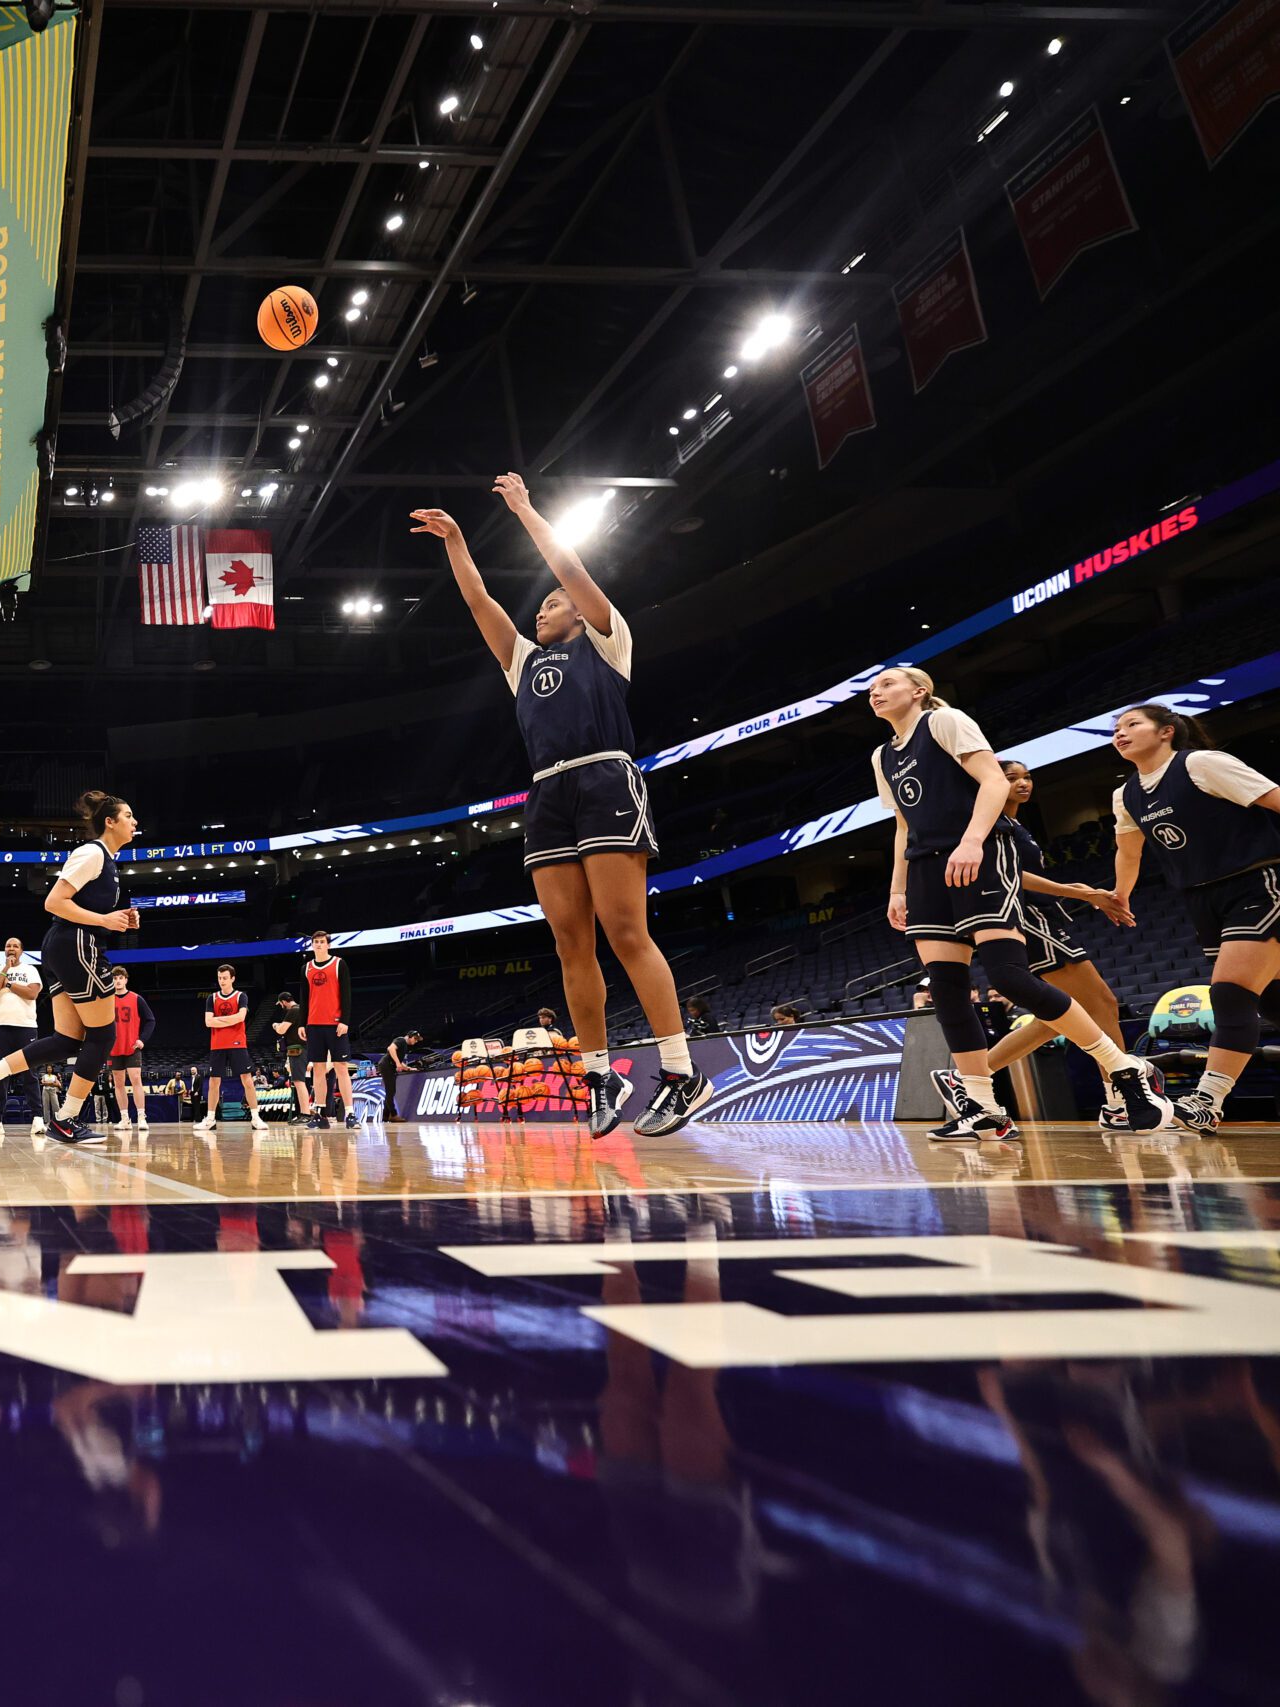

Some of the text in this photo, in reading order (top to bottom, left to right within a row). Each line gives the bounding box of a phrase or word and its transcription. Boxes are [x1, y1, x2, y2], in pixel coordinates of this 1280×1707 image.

[280, 299, 301, 338] Wilson
[1012, 506, 1198, 614] UCONN HUSKIES
[539, 671, 555, 691] 21
[738, 708, 801, 737] FOUR ALL
[891, 759, 918, 781] HUSKIES
[903, 783, 915, 800] 5
[468, 791, 529, 815] UCONN HUSKI
[1140, 806, 1174, 823] HUSKIES
[1158, 827, 1180, 844] 20
[147, 841, 256, 858] 3PT 1/1 FT 0/0
[156, 895, 190, 906] FOUR
[195, 893, 219, 904] ALL
[808, 906, 834, 925] BAY
[400, 929, 426, 939] FINAL
[429, 924, 454, 935] FOUR
[459, 960, 532, 980] FOUR ALL
